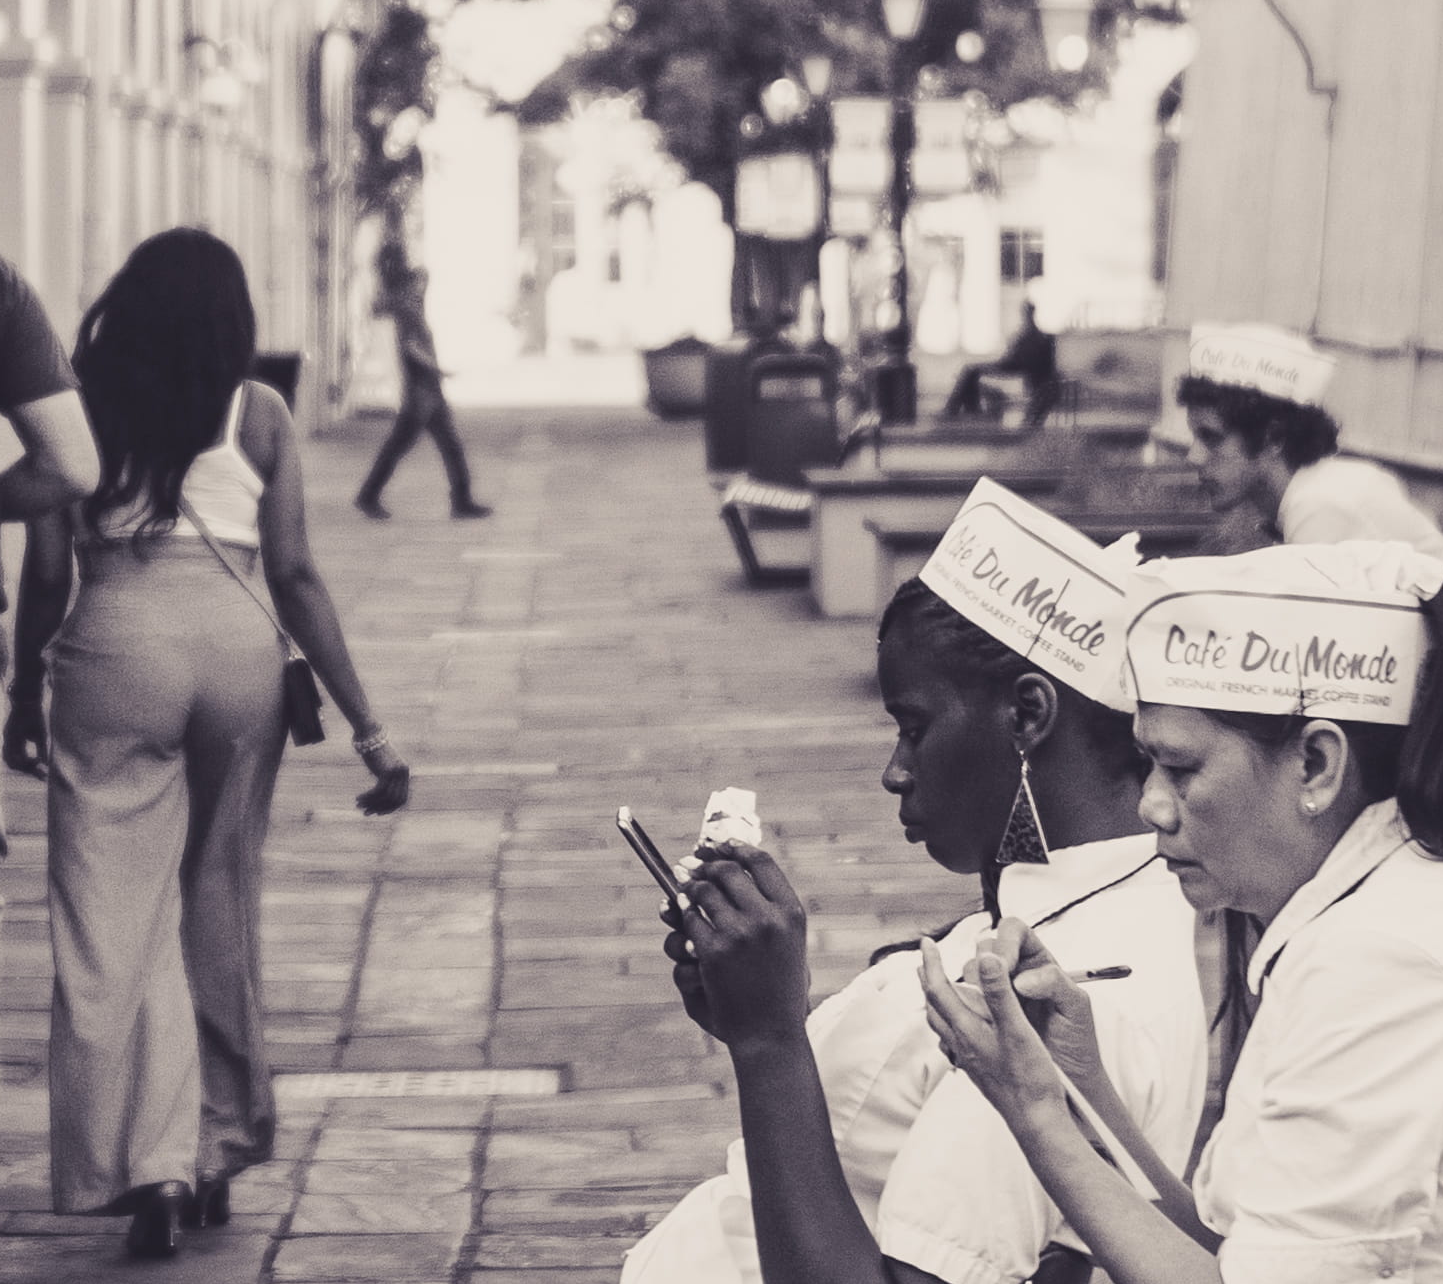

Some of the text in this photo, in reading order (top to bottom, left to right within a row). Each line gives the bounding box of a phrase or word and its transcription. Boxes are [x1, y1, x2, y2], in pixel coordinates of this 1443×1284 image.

[1255, 357, 1299, 384] Monde
[972, 547, 1010, 597] Du
[1011, 577, 1105, 656] Monde
[980, 598, 1016, 628] MARKET
[1017, 624, 1053, 653] COFFEE
[1054, 648, 1086, 672] STAND
[1165, 624, 1398, 684] Café Du Monde
[1221, 681, 1268, 695] FRENCH
